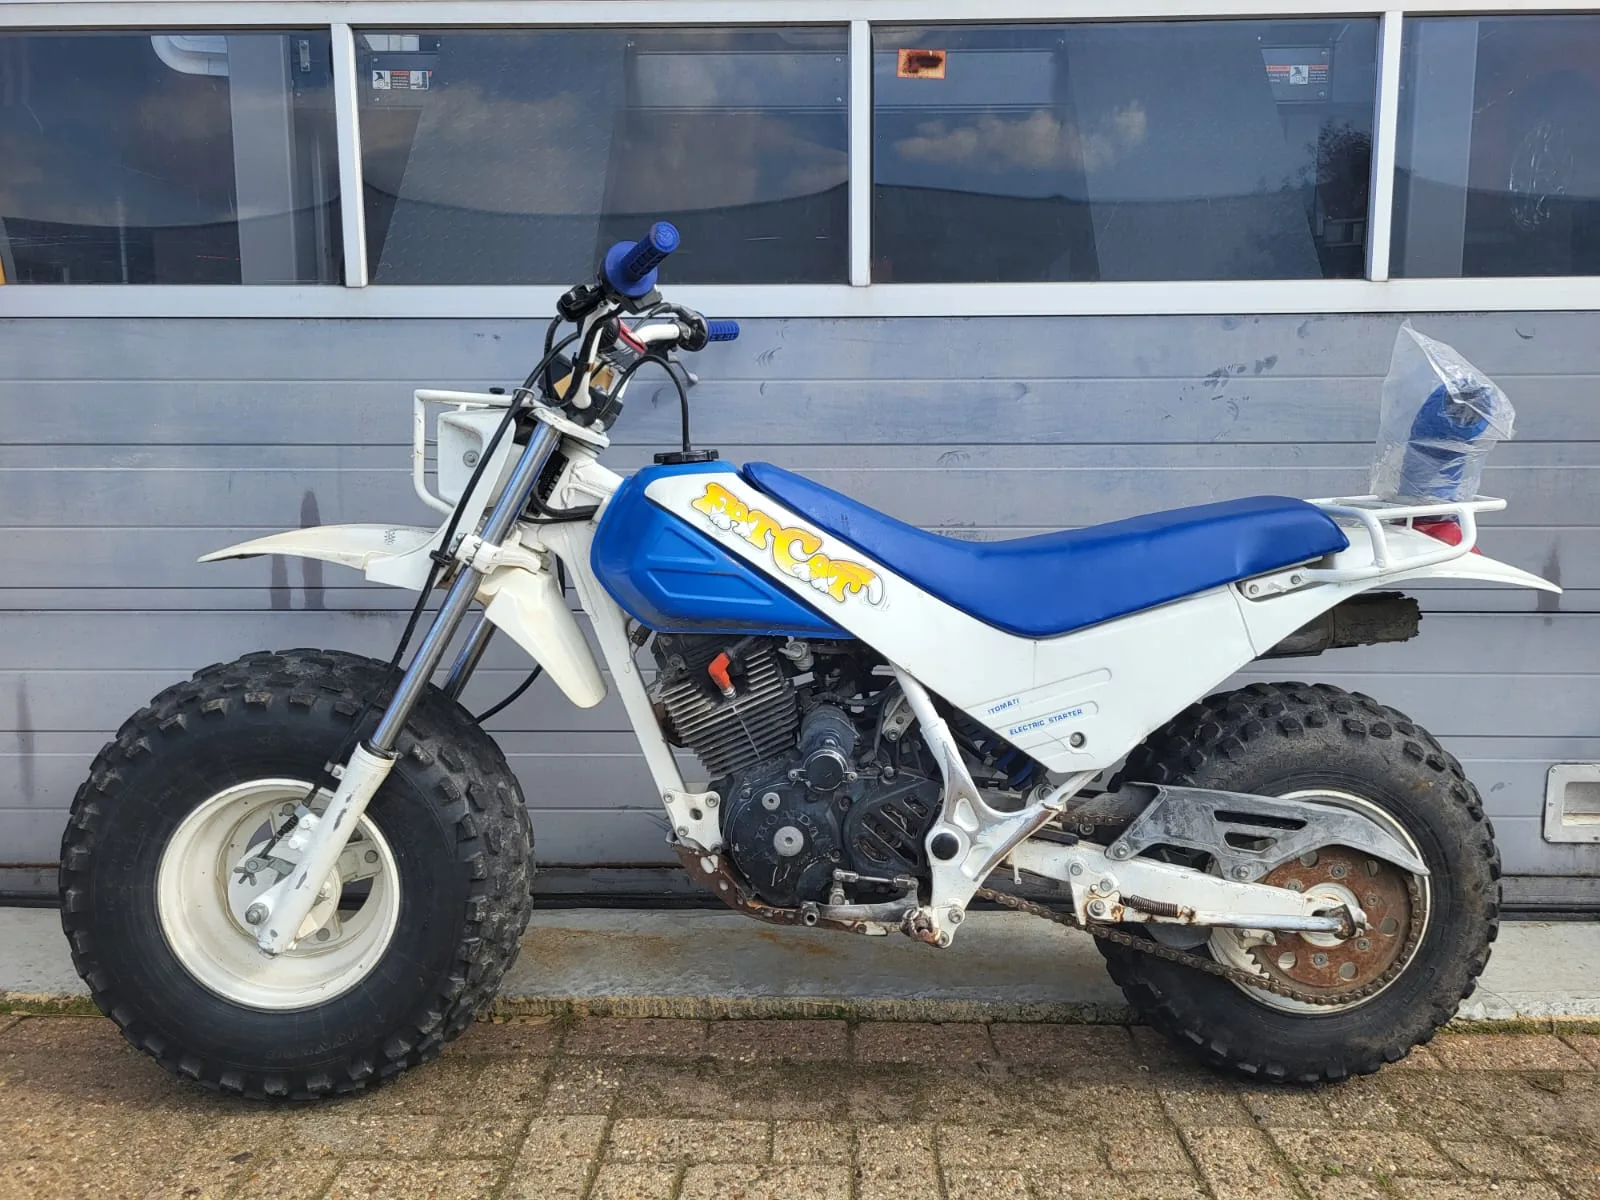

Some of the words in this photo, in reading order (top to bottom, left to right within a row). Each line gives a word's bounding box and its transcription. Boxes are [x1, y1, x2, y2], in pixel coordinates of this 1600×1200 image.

[1009, 720, 1045, 735] ELECTRIC
[1048, 708, 1083, 724] STARTER
[754, 808, 819, 842] HONDA
